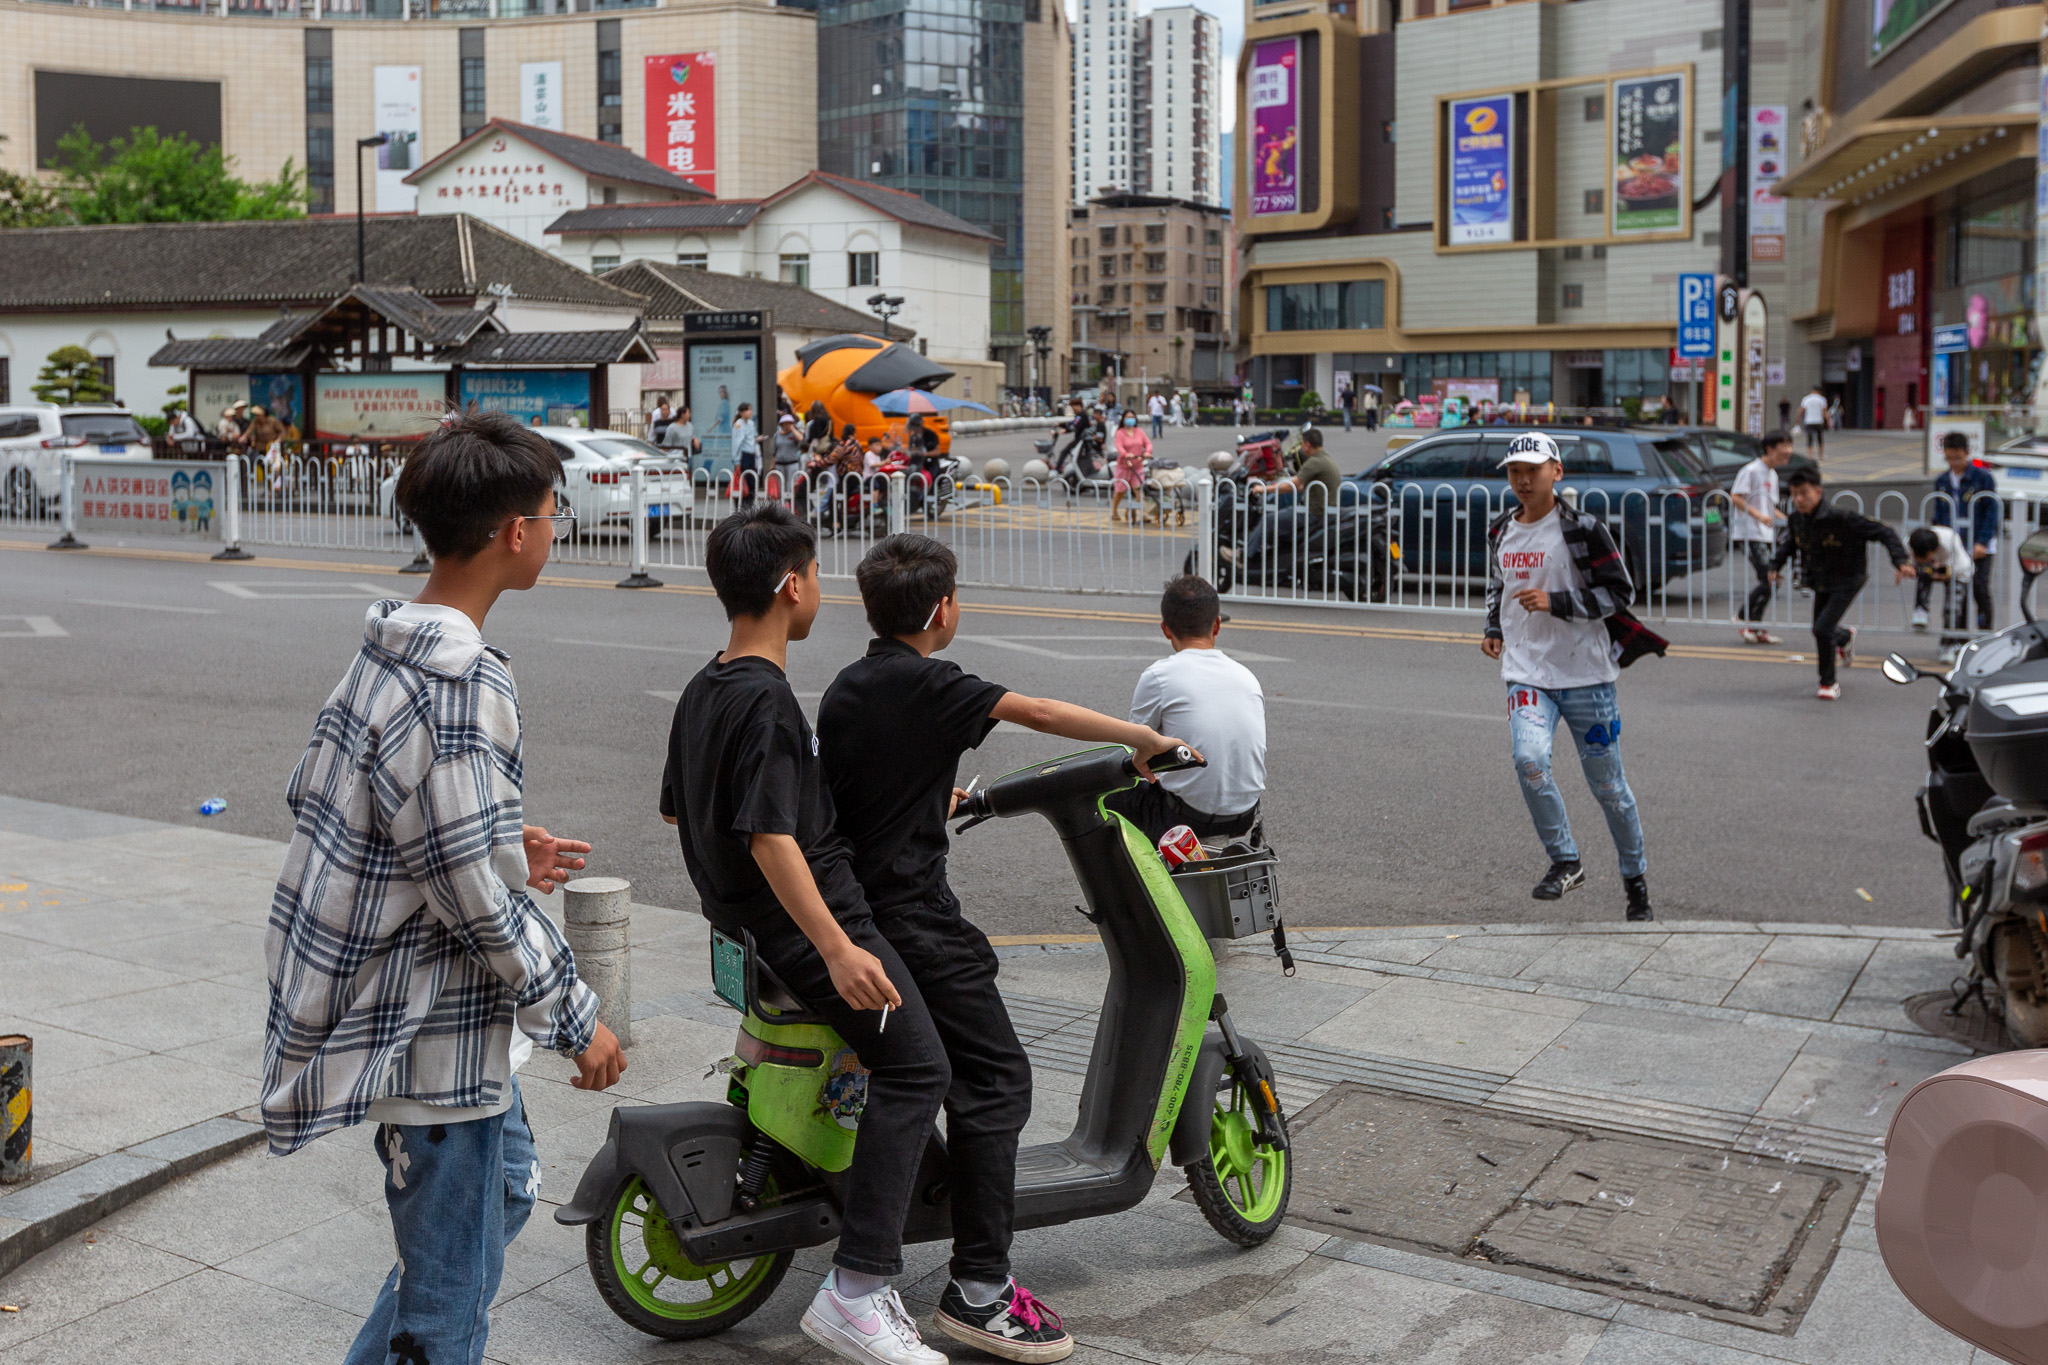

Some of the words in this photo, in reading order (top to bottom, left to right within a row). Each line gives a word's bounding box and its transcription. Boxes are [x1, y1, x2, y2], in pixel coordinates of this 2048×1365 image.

[666, 91, 696, 171] 米高电
[1683, 277, 1703, 323] P
[83, 475, 170, 497] 人人讲交通安全
[1502, 551, 1546, 569] GIVENCHY
[1515, 570, 1530, 580] PARIS
[1166, 1044, 1194, 1115] 400-780-8835
